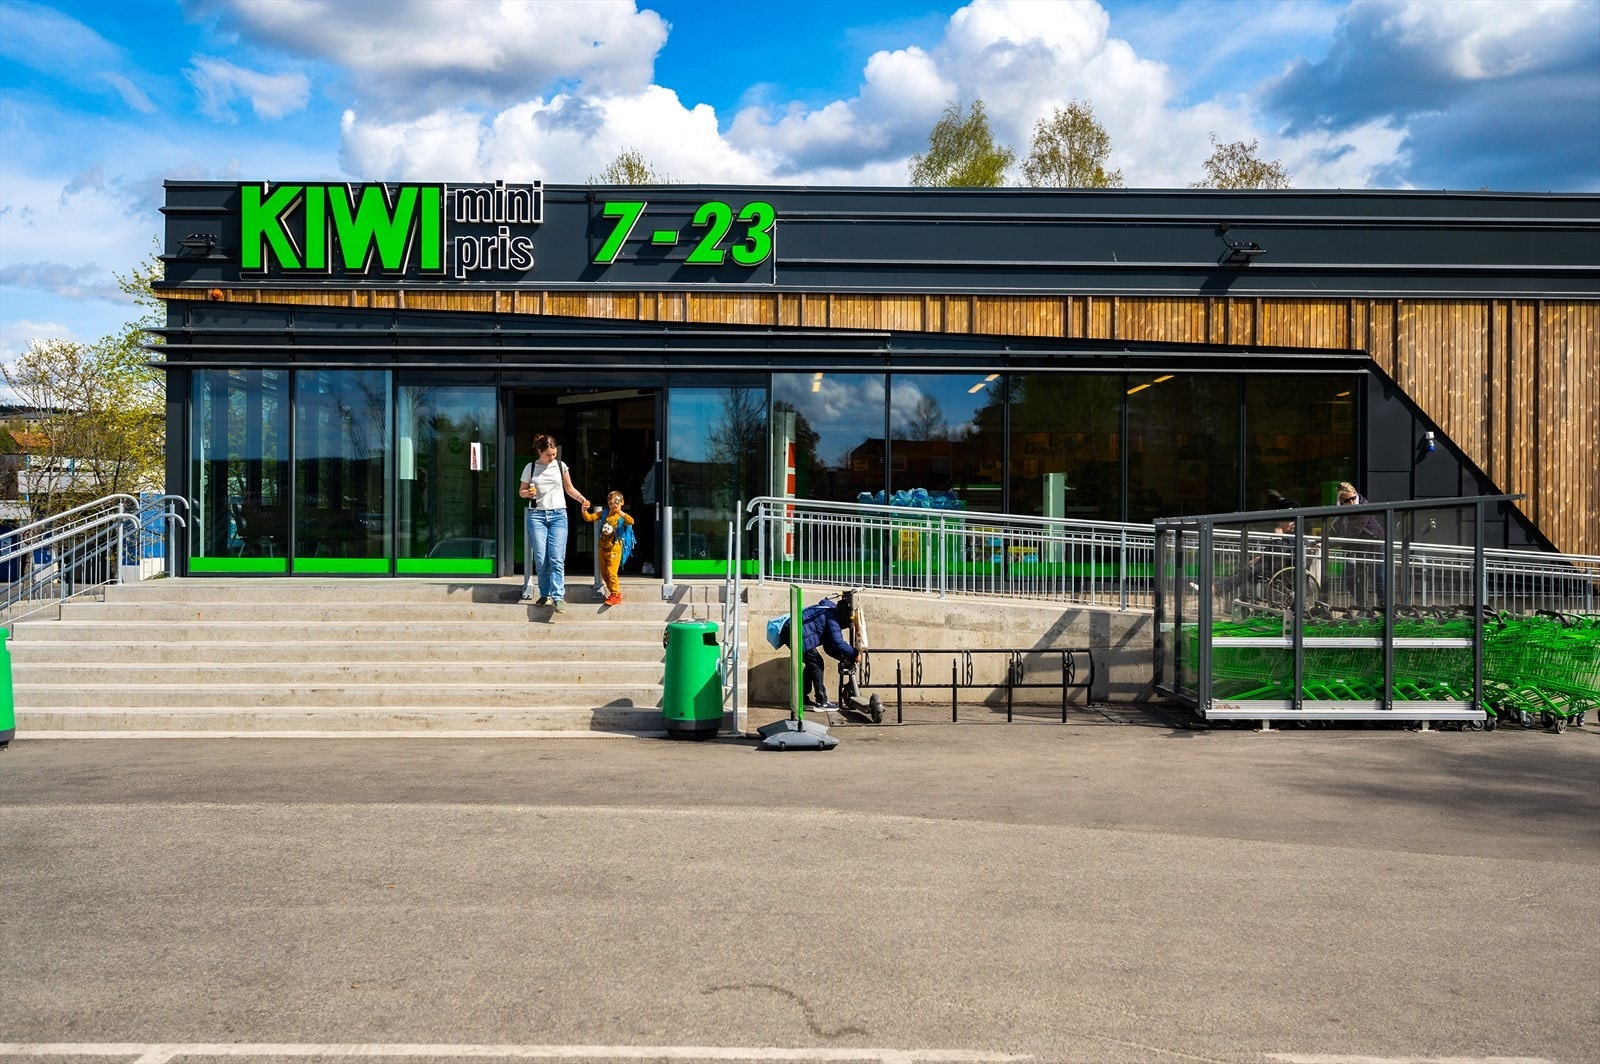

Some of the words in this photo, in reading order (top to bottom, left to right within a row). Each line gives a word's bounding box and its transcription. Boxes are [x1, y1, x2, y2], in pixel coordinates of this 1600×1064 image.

[240, 183, 441, 272] KIWI
[455, 180, 543, 223] mini
[455, 226, 534, 279] pris
[593, 201, 647, 264] 7
[652, 230, 679, 245] -
[684, 201, 775, 266] 23
